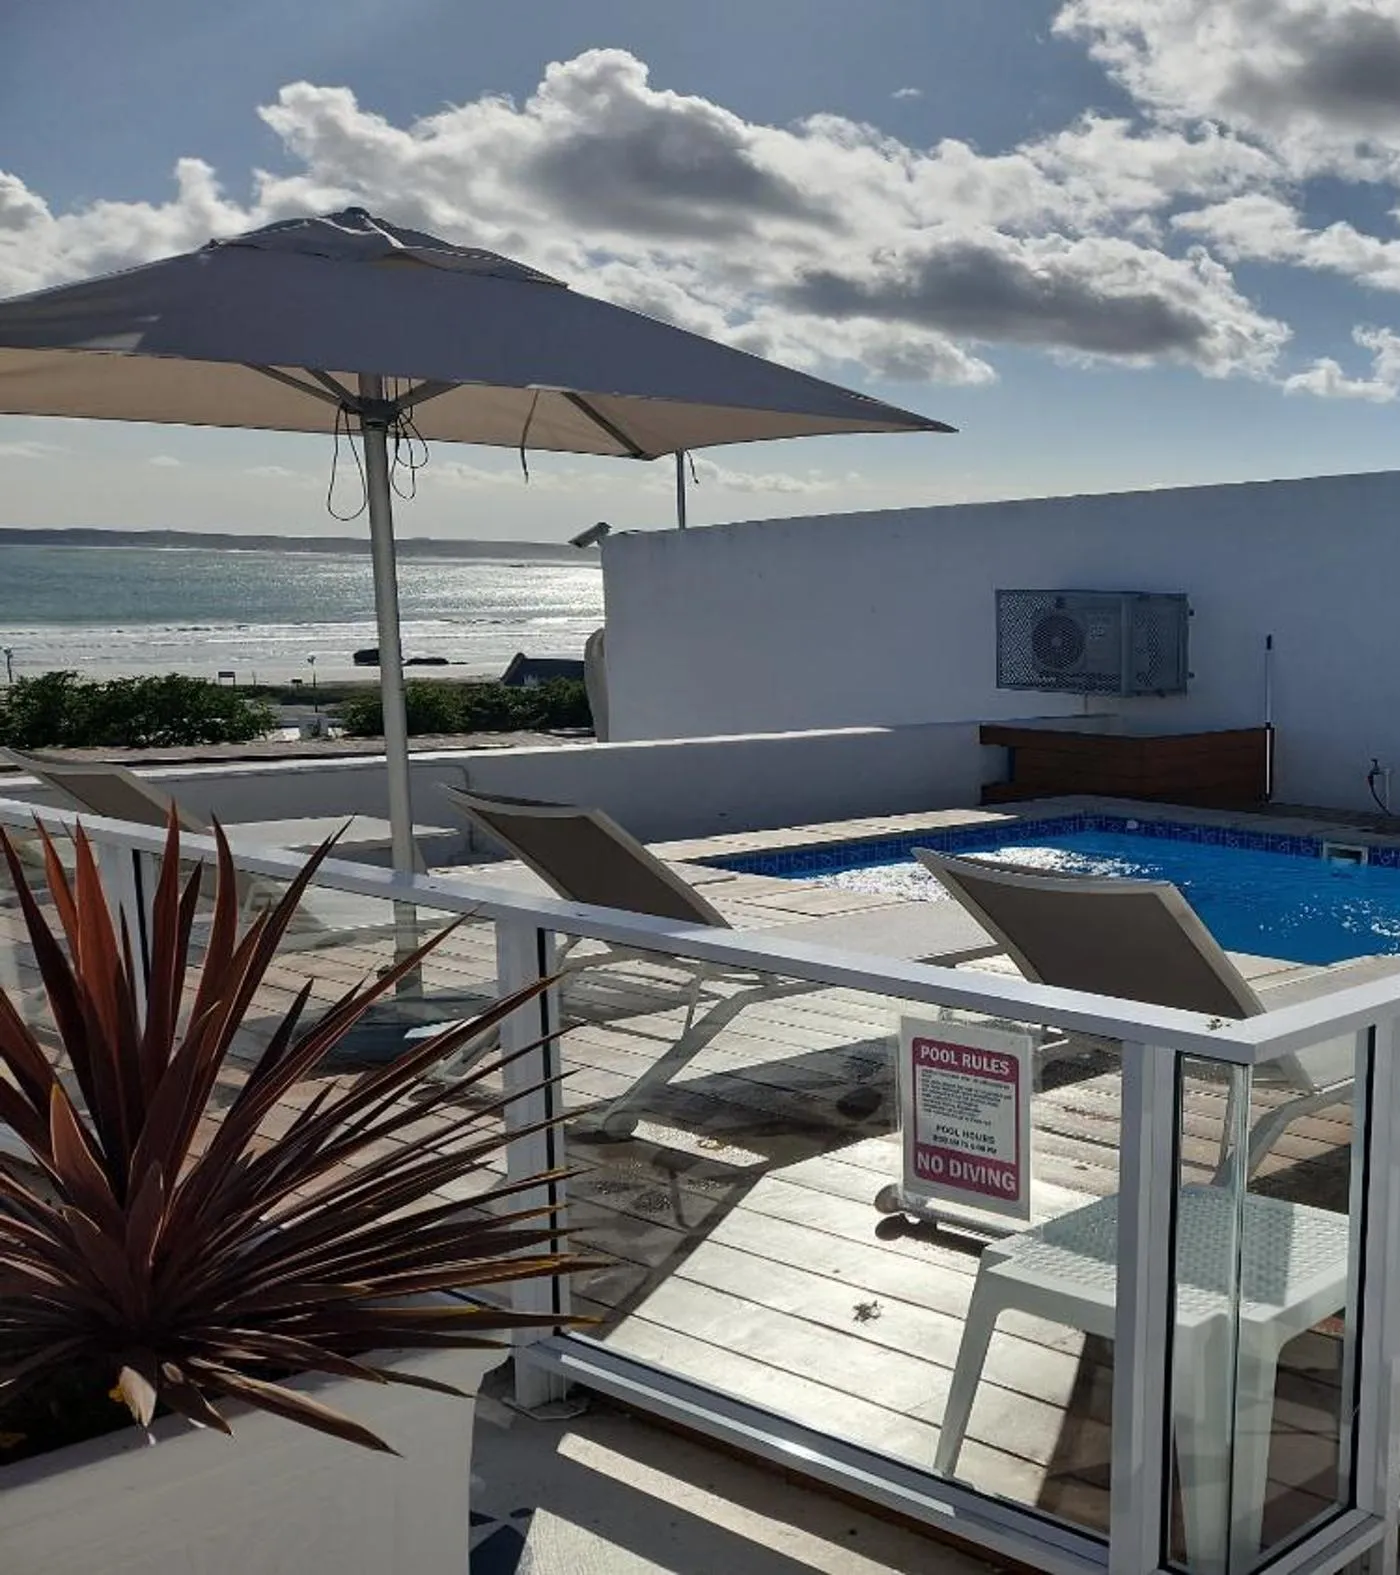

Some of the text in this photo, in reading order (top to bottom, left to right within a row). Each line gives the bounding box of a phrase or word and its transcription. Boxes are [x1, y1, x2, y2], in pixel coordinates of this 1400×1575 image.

[920, 1045, 1010, 1076] POOL RULES
[936, 1124, 960, 1137] POOL
[917, 1151, 1016, 1192] NO DIVING
